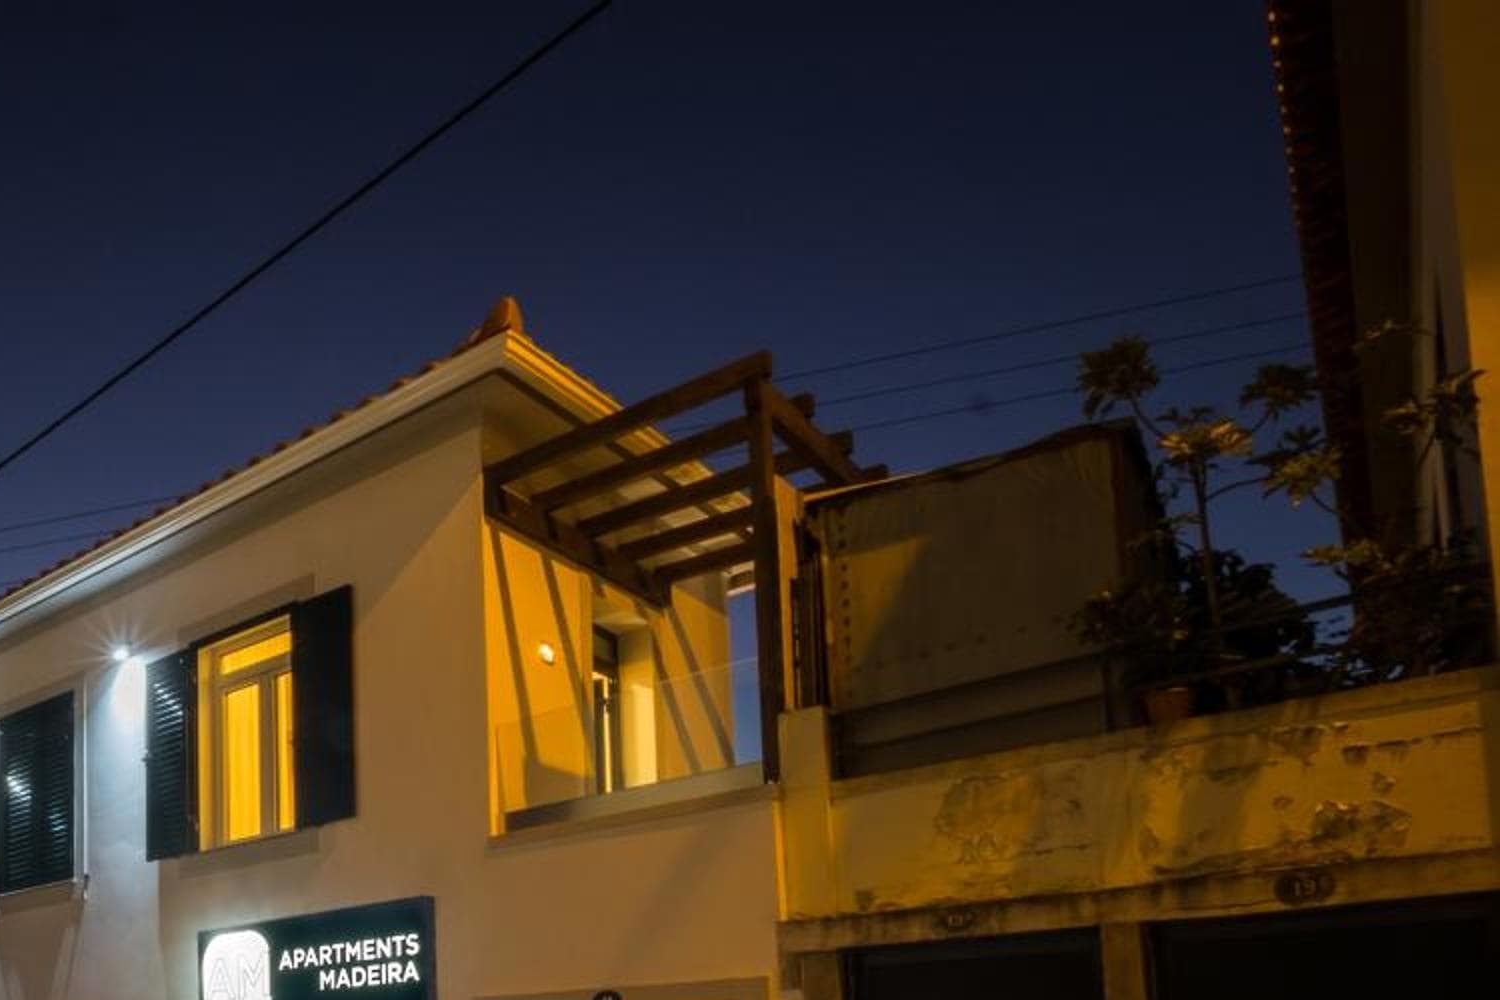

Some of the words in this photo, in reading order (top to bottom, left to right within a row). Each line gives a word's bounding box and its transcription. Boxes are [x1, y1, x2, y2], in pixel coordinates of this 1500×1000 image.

[279, 934, 420, 971] APARTMENTS
[206, 953, 270, 1000] AM
[318, 961, 420, 991] MADEIRA
